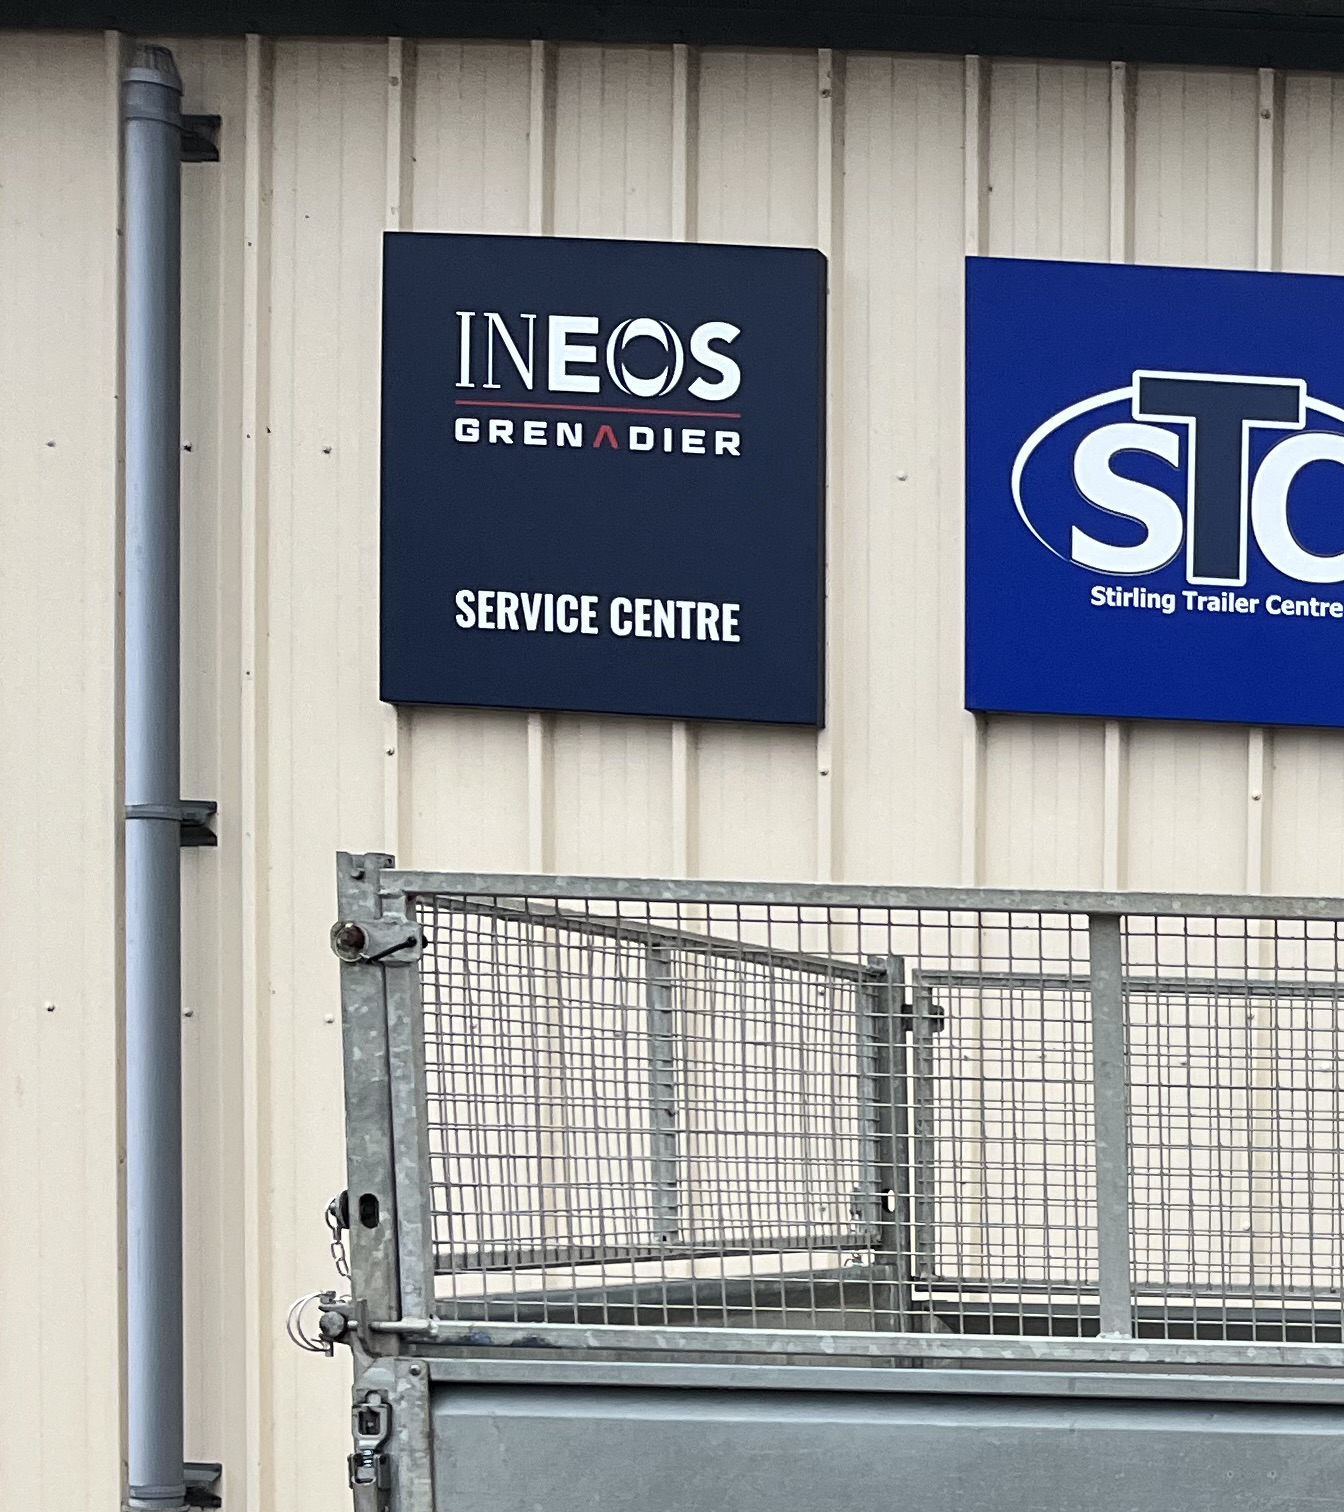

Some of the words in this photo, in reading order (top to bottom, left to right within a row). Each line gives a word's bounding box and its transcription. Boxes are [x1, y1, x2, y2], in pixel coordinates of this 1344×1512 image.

[454, 311, 741, 401] INEOS
[454, 417, 741, 457] GRENADIER
[455, 589, 599, 635] SERVICE
[610, 596, 741, 643] CENTRE
[1090, 585, 1176, 614] Stirling
[1182, 590, 1260, 614] Trailer
[1265, 594, 1344, 618] Centre
